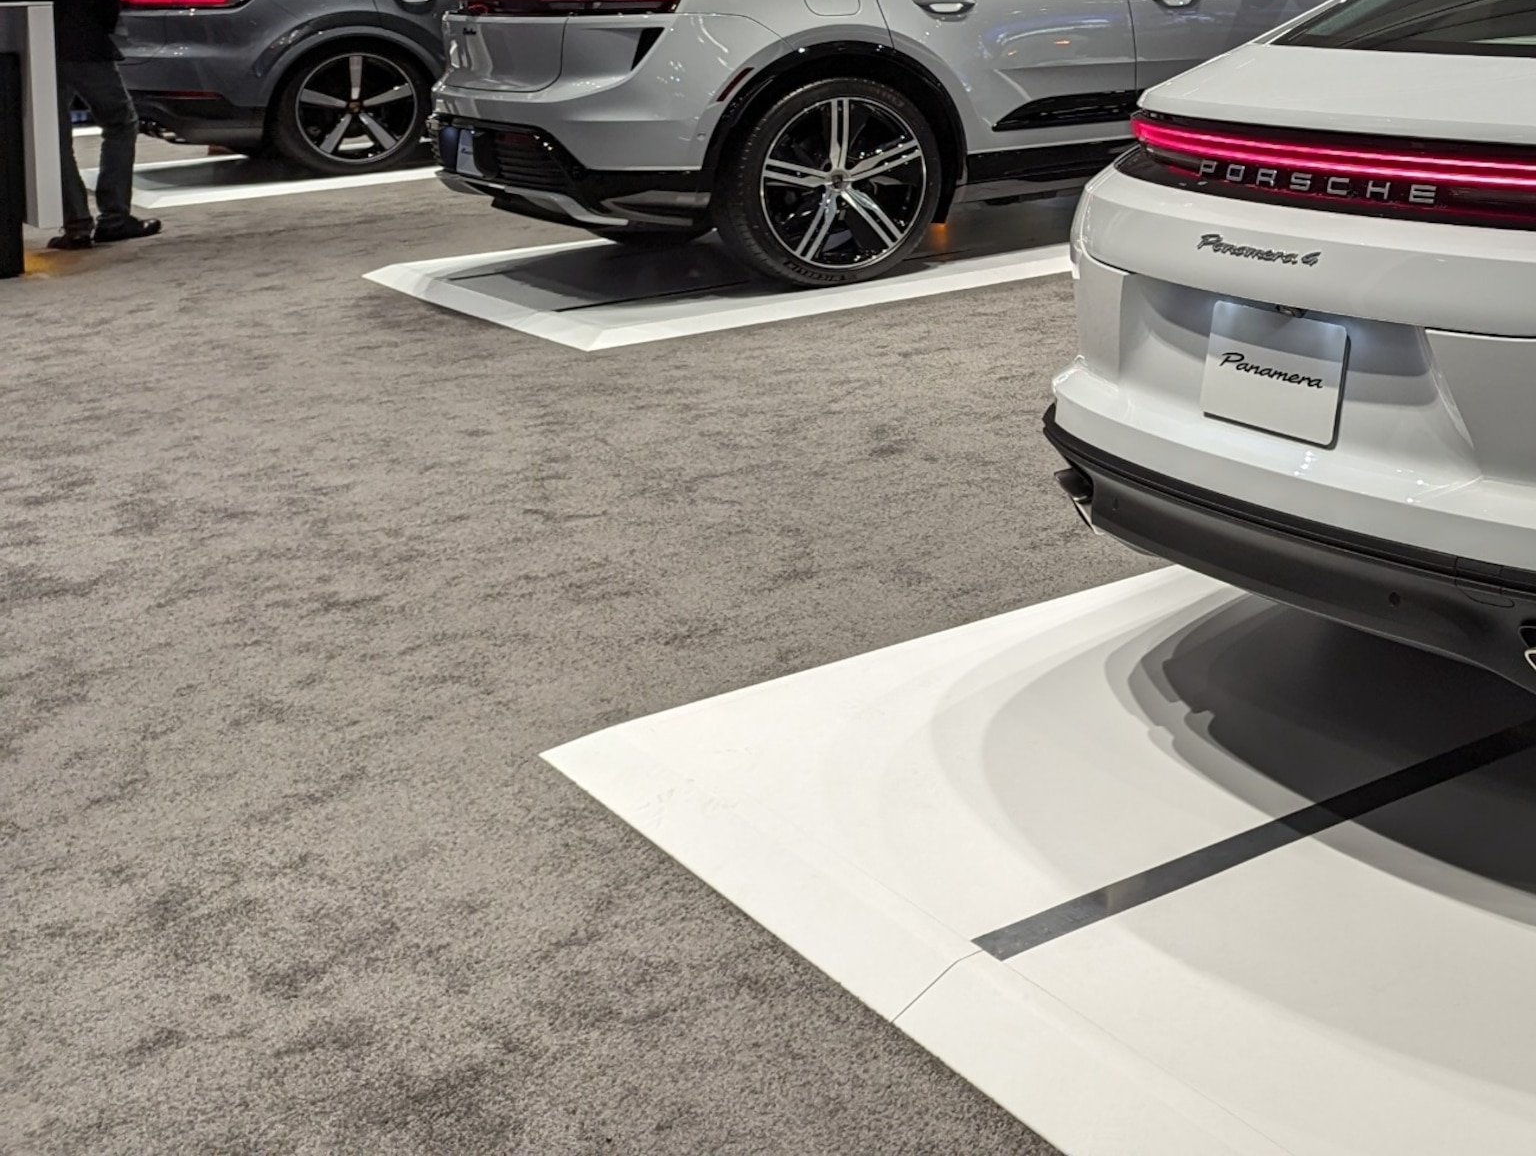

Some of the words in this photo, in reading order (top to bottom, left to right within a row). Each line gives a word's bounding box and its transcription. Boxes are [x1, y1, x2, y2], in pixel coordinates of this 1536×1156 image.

[1199, 160, 1437, 205] PORSCHE
[1197, 233, 1299, 266] Panamera
[1301, 251, 1322, 267] 4
[1219, 352, 1323, 389] Panamera
